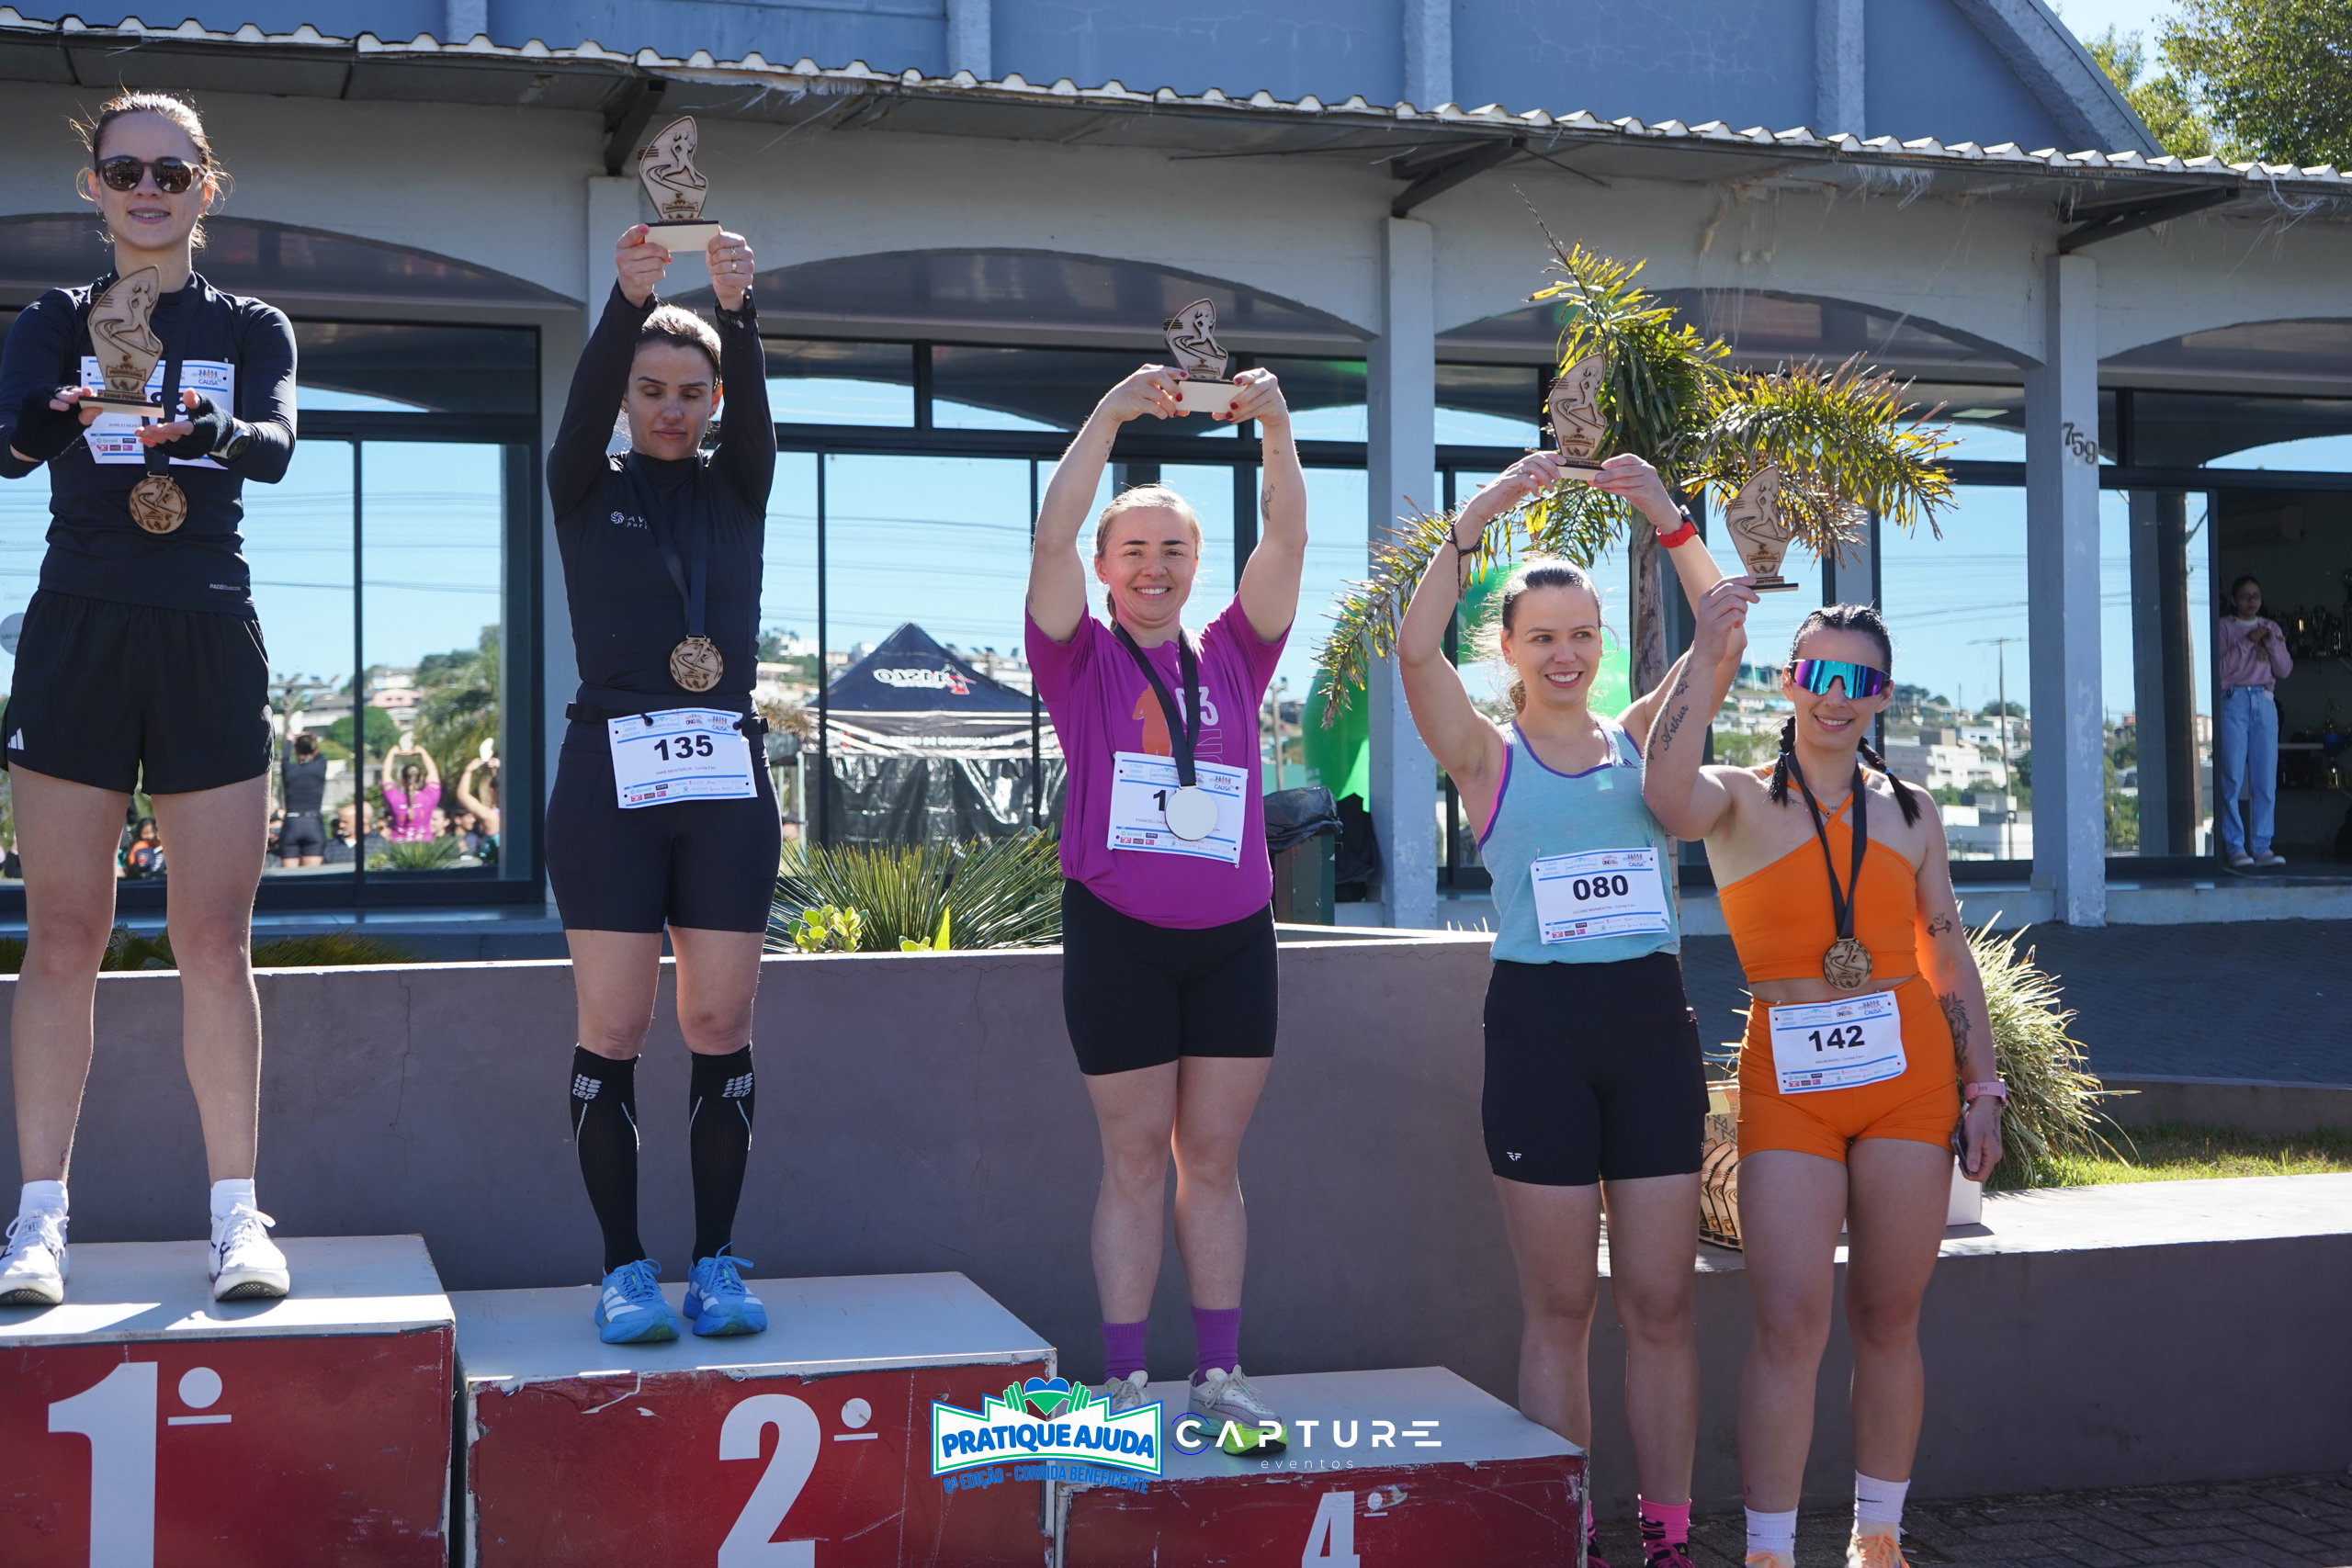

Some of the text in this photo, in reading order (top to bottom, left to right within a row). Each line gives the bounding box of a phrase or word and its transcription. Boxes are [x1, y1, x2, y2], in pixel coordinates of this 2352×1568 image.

[2063, 422, 2098, 465] 759
[1661, 705, 1689, 750] Arthur
[654, 735, 713, 761] 135
[1573, 874, 1628, 900] 080
[1808, 1025, 1865, 1052] 142
[572, 1088, 596, 1100] cep
[722, 1088, 751, 1099] cep
